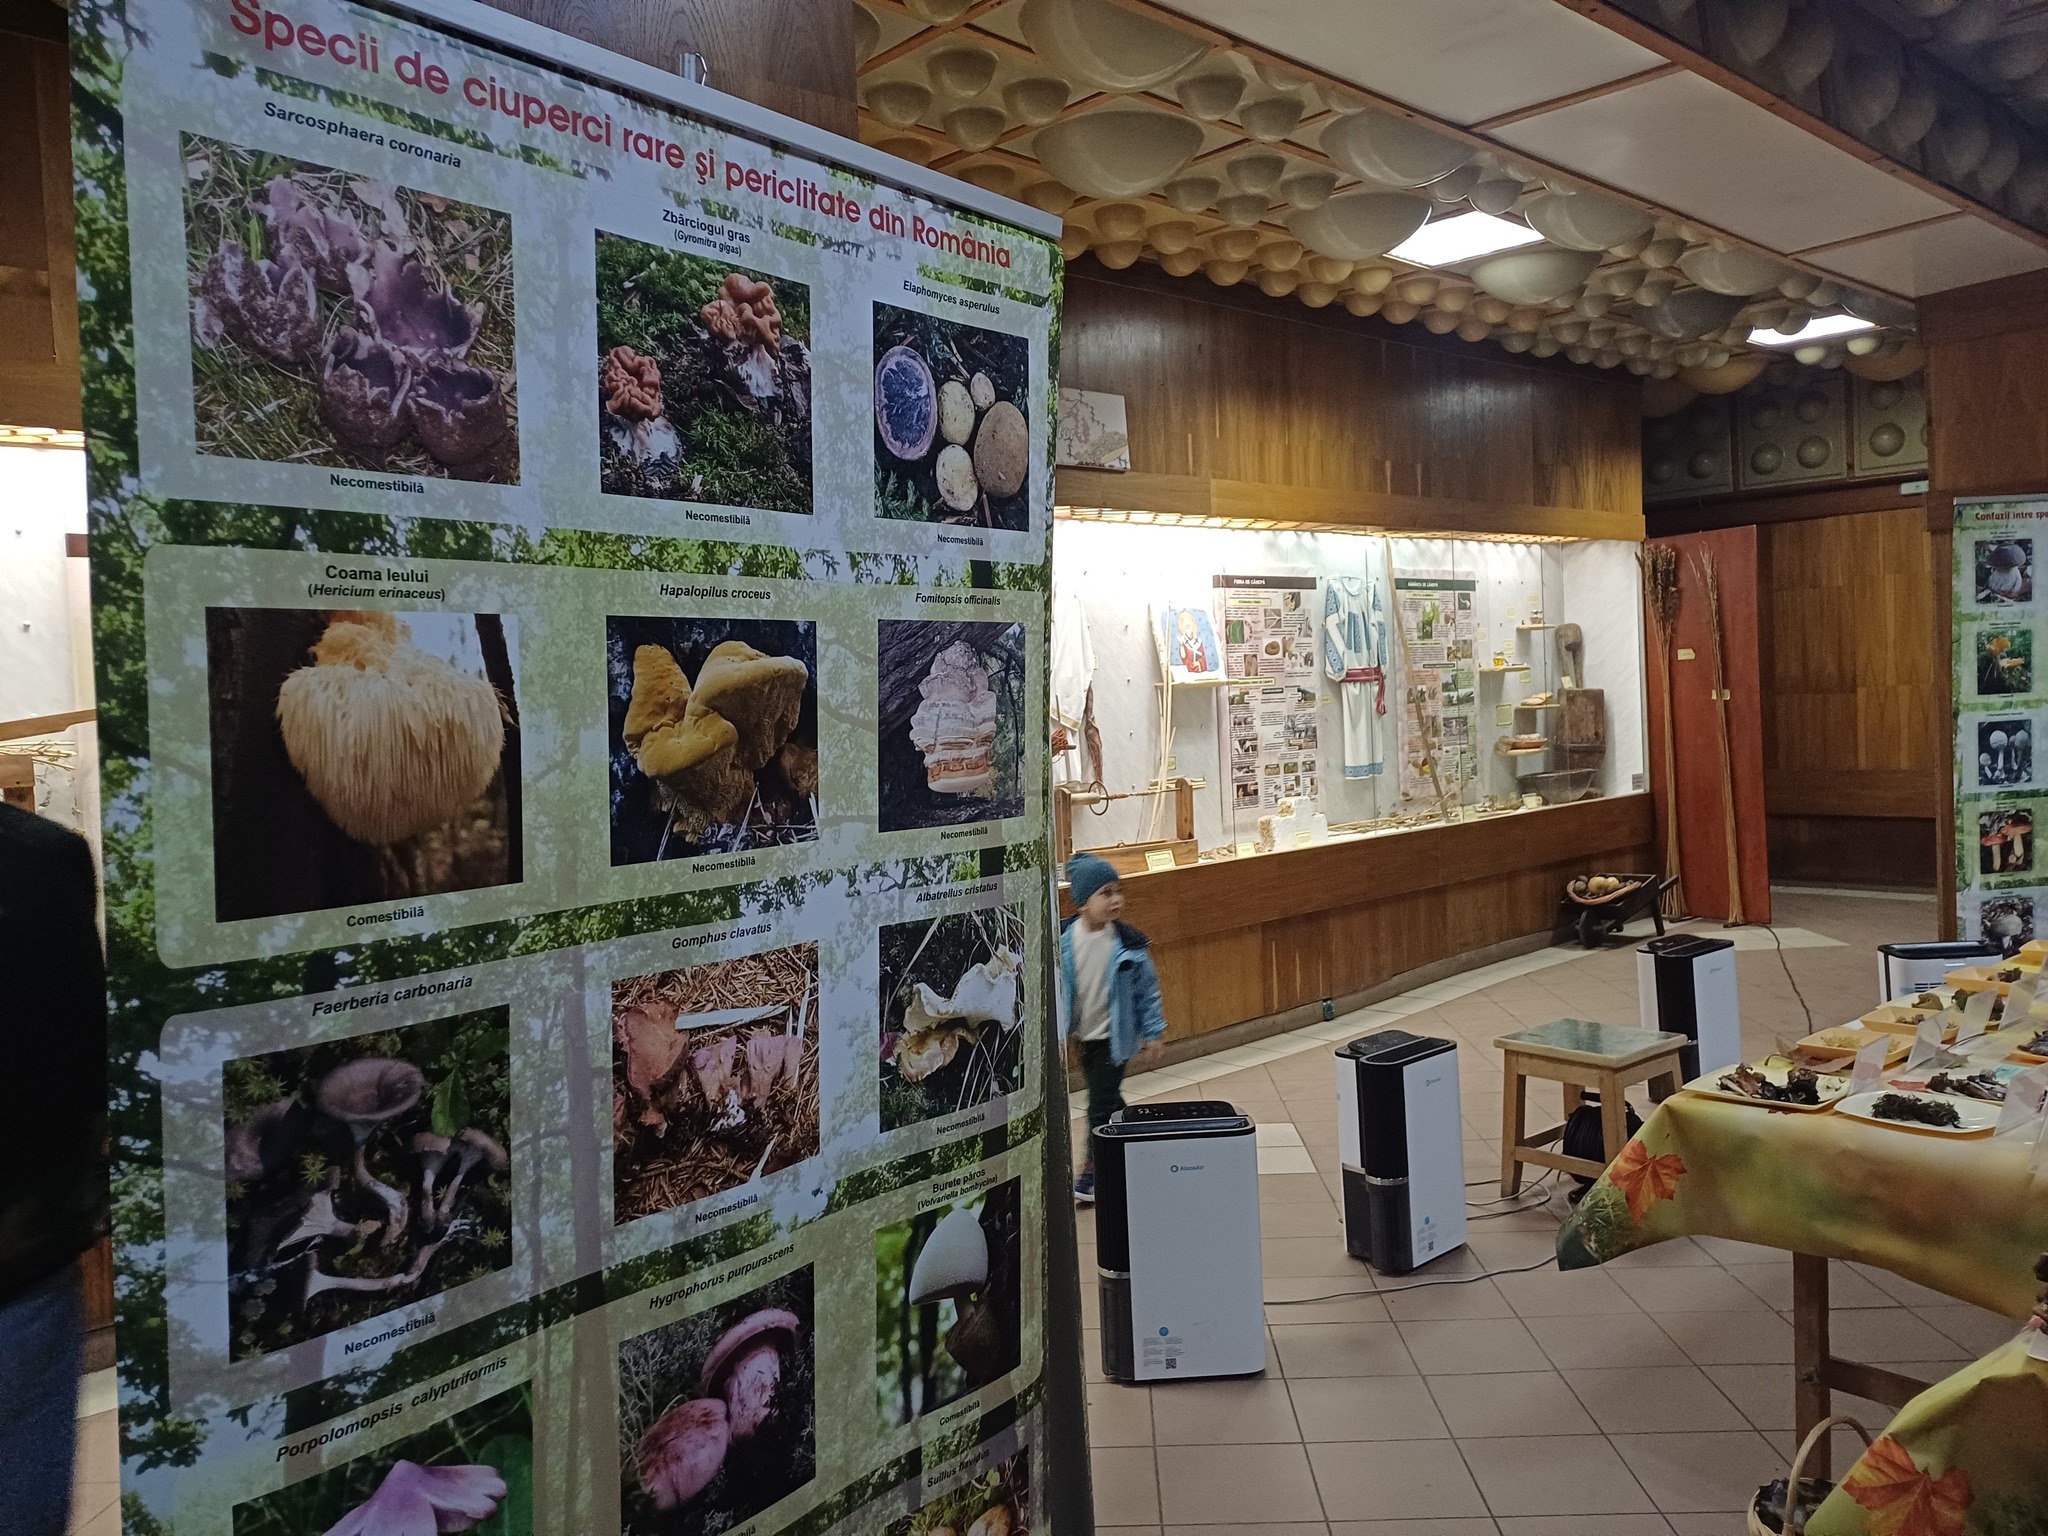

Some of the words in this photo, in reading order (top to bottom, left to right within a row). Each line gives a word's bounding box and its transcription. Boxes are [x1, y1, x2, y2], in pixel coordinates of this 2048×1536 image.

[230, 0, 379, 73] Specii
[394, 51, 450, 94] de
[463, 76, 612, 147] ciuperci
[623, 127, 685, 169] rare
[725, 160, 861, 223] periclitate
[868, 204, 905, 238] din
[913, 215, 1010, 268] România
[264, 102, 384, 146] Sarcosphaera
[389, 137, 461, 168] coronaria
[662, 208, 724, 237] Zbârciogul
[727, 228, 750, 244] gras
[674, 229, 717, 250] (Gyromitra
[718, 239, 742, 257] gigas)
[903, 280, 957, 305] Elaphomyces
[959, 295, 1000, 315] asperulus
[330, 473, 424, 494] Necomestibilă
[685, 510, 751, 525] Necomestibilă
[937, 534, 984, 546] Necomestibilă
[325, 565, 382, 581] Coama
[387, 568, 429, 583] leului
[308, 583, 375, 598] (Hericium
[378, 587, 445, 602] erinaceus)
[659, 583, 728, 599] Hapalopilus
[731, 589, 771, 600] croceus
[915, 593, 962, 606] Fomitopsis
[964, 594, 1001, 606] officinalis
[940, 826, 988, 840] Necomestibilă
[692, 856, 756, 874] Necomestibilă
[915, 888, 963, 903] Albatrellus
[964, 882, 998, 896] cristatus
[346, 905, 425, 927] Comestibilă
[671, 931, 727, 949] Gomphus
[729, 923, 772, 939] clavatus
[312, 991, 389, 1017] Faerberia
[393, 975, 473, 1001] carbonaria
[936, 1113, 985, 1135] Necomestibilă
[917, 1190, 959, 1211] (Volvariella
[959, 1174, 998, 1195] bombycina)
[932, 1176, 961, 1194] Burete
[963, 1168, 986, 1185] păros
[695, 1193, 758, 1224] Necomestibilă
[649, 1273, 725, 1310] Hygrophorus
[727, 1243, 795, 1283] purpurascens
[344, 1312, 436, 1355] Necomestibilă
[276, 1401, 402, 1462] Porpolomopsis
[410, 1355, 507, 1407] calyptriformis
[939, 1400, 981, 1426] Comestibilă
[927, 1467, 957, 1488] Suillus
[958, 1448, 990, 1472] flavidus
